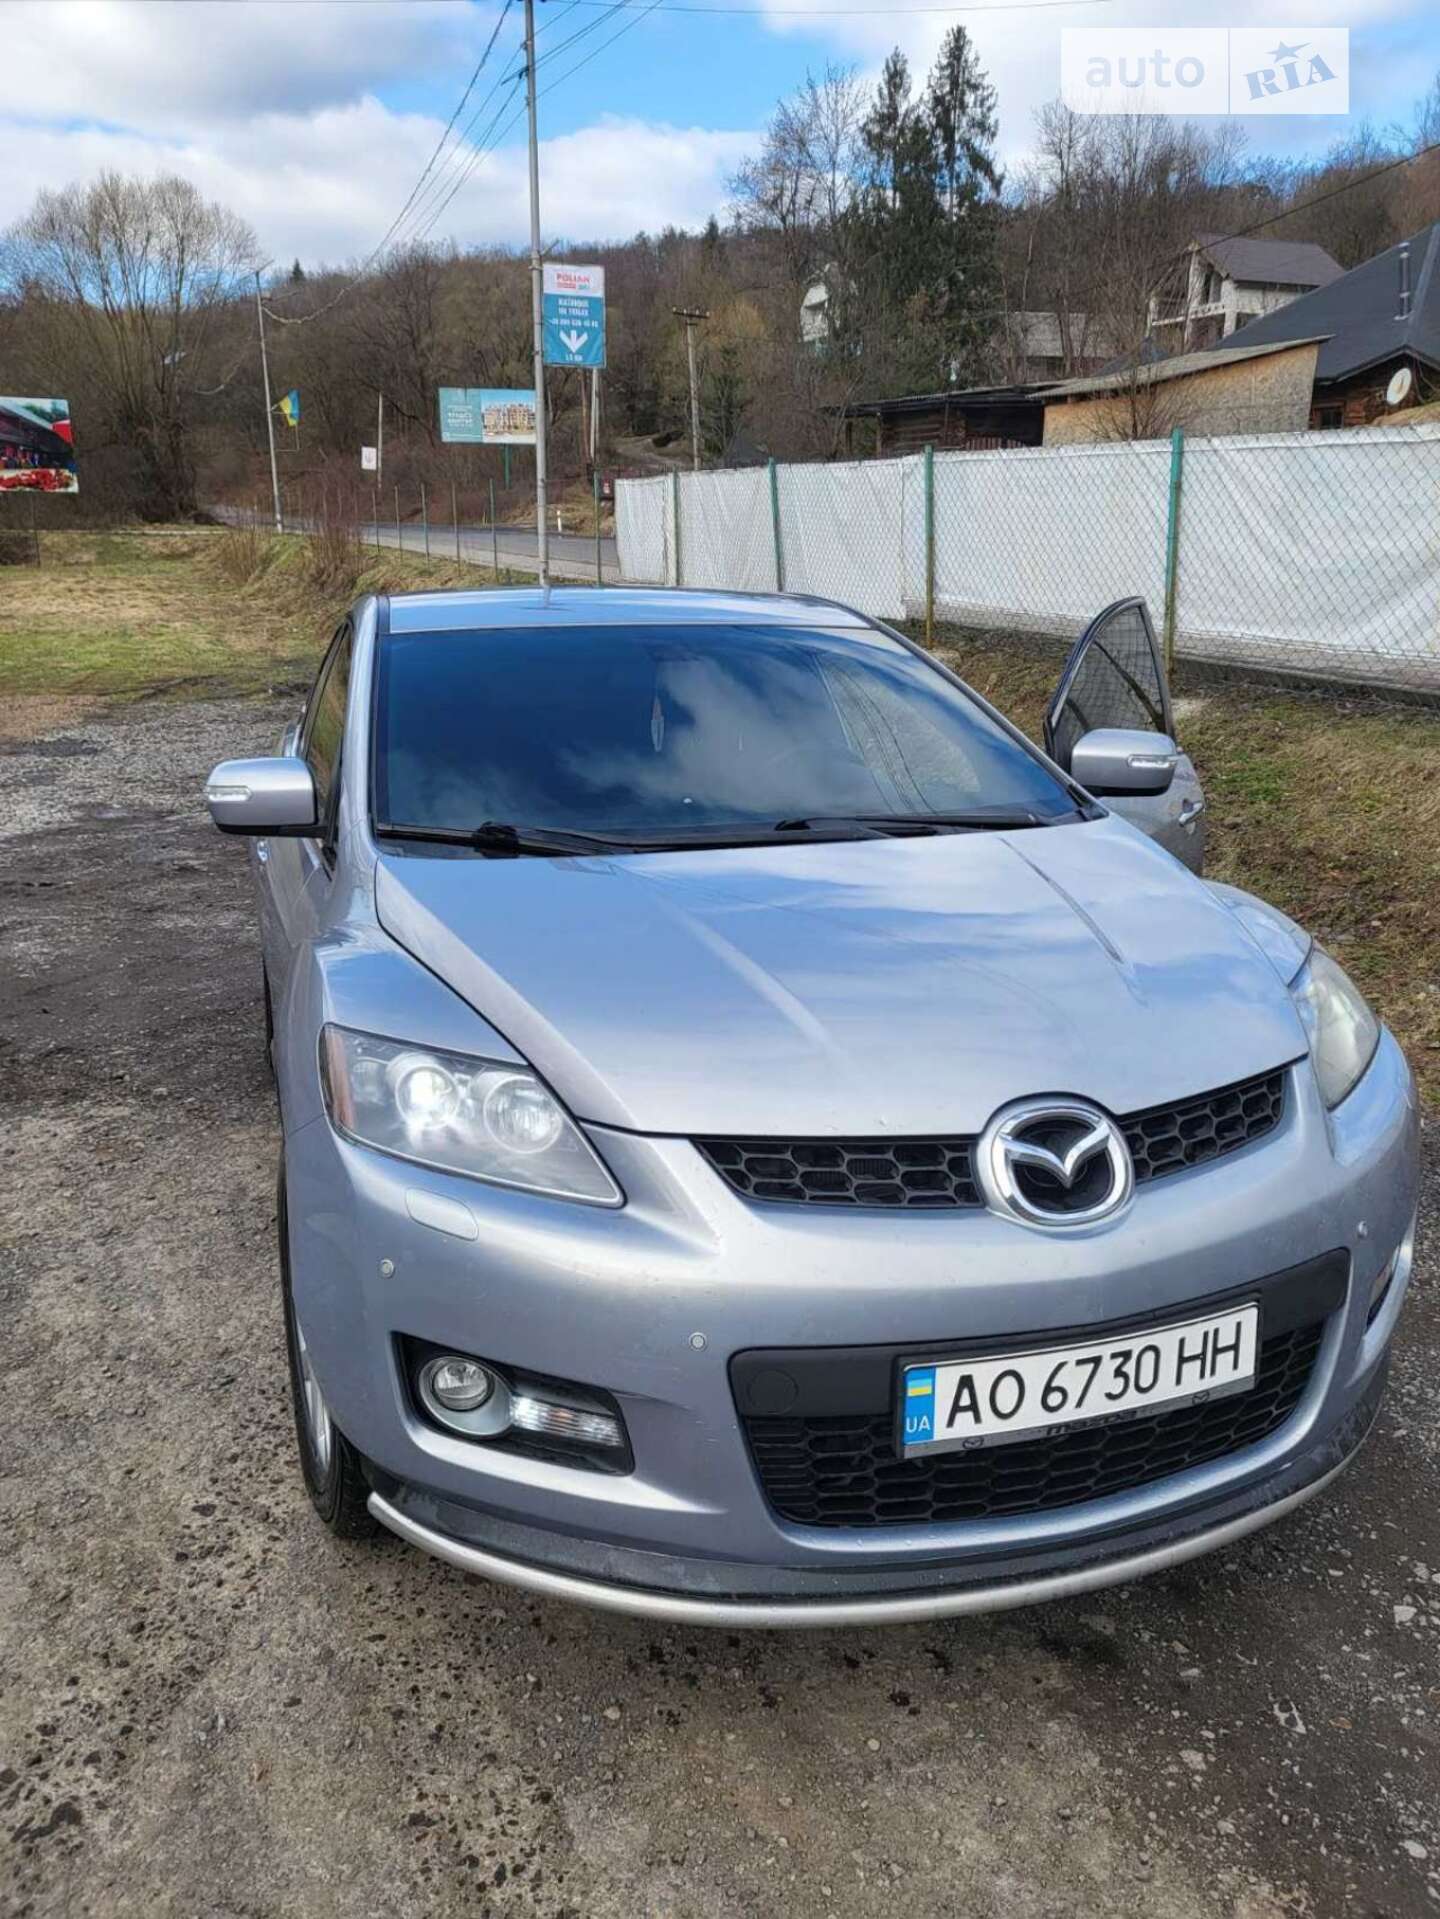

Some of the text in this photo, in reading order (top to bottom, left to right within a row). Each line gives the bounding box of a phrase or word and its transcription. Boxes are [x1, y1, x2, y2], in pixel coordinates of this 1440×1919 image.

[906, 1320, 1242, 1433] UA AO 6730 HH
